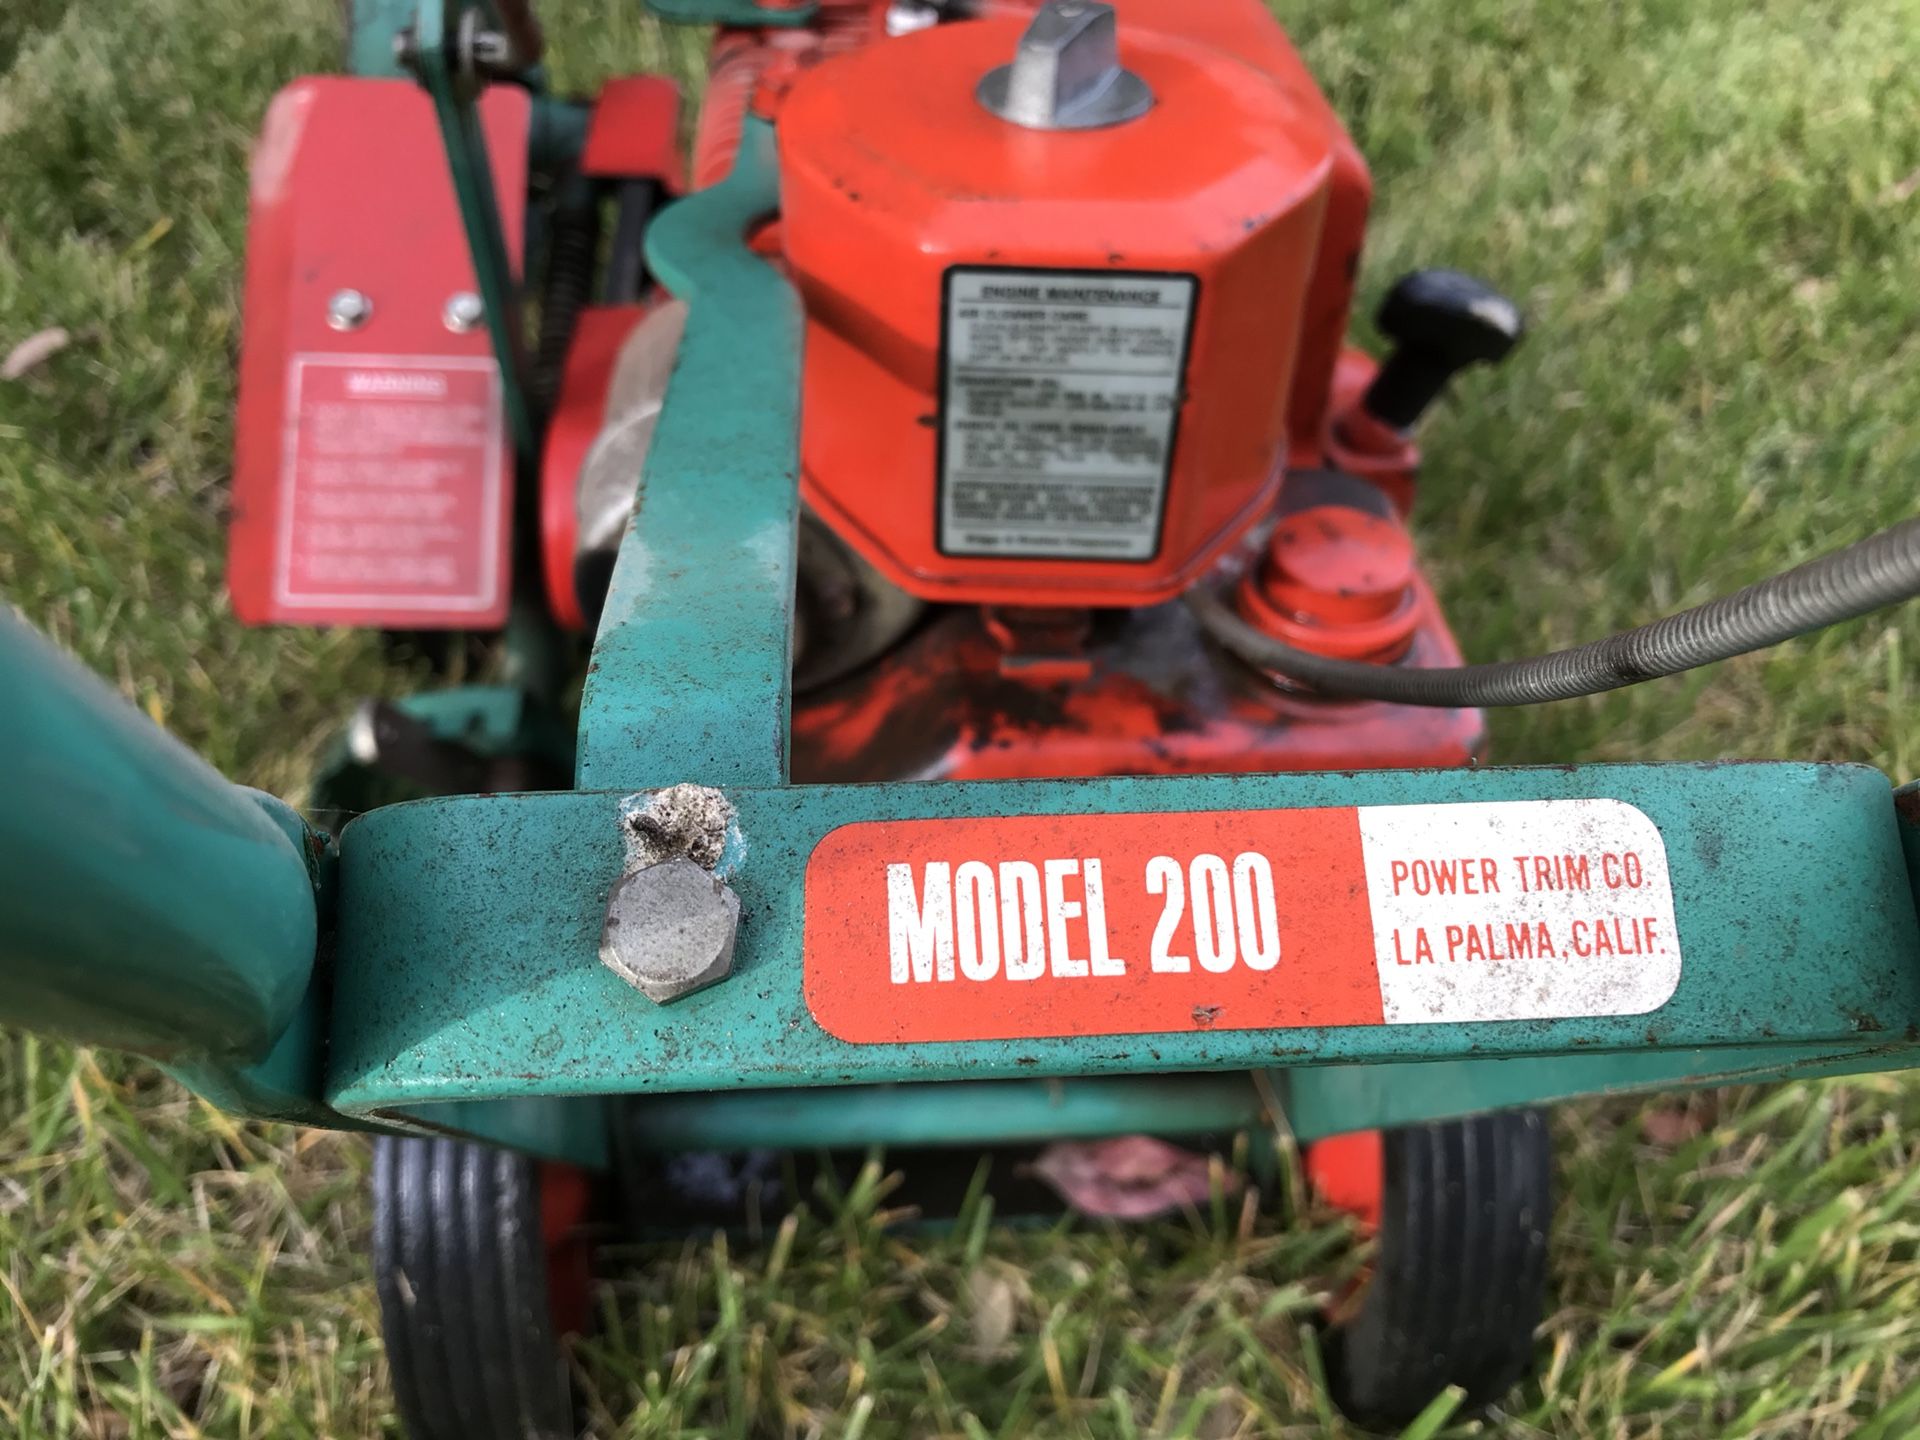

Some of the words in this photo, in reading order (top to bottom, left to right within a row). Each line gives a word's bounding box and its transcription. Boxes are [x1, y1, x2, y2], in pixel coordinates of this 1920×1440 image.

[1391, 857, 1500, 897] POWER
[1513, 854, 1592, 893] TRIM
[1601, 851, 1652, 889] CO.
[886, 858, 1127, 984] MODEL
[1145, 851, 1281, 973] 200
[1393, 927, 1434, 966] LA
